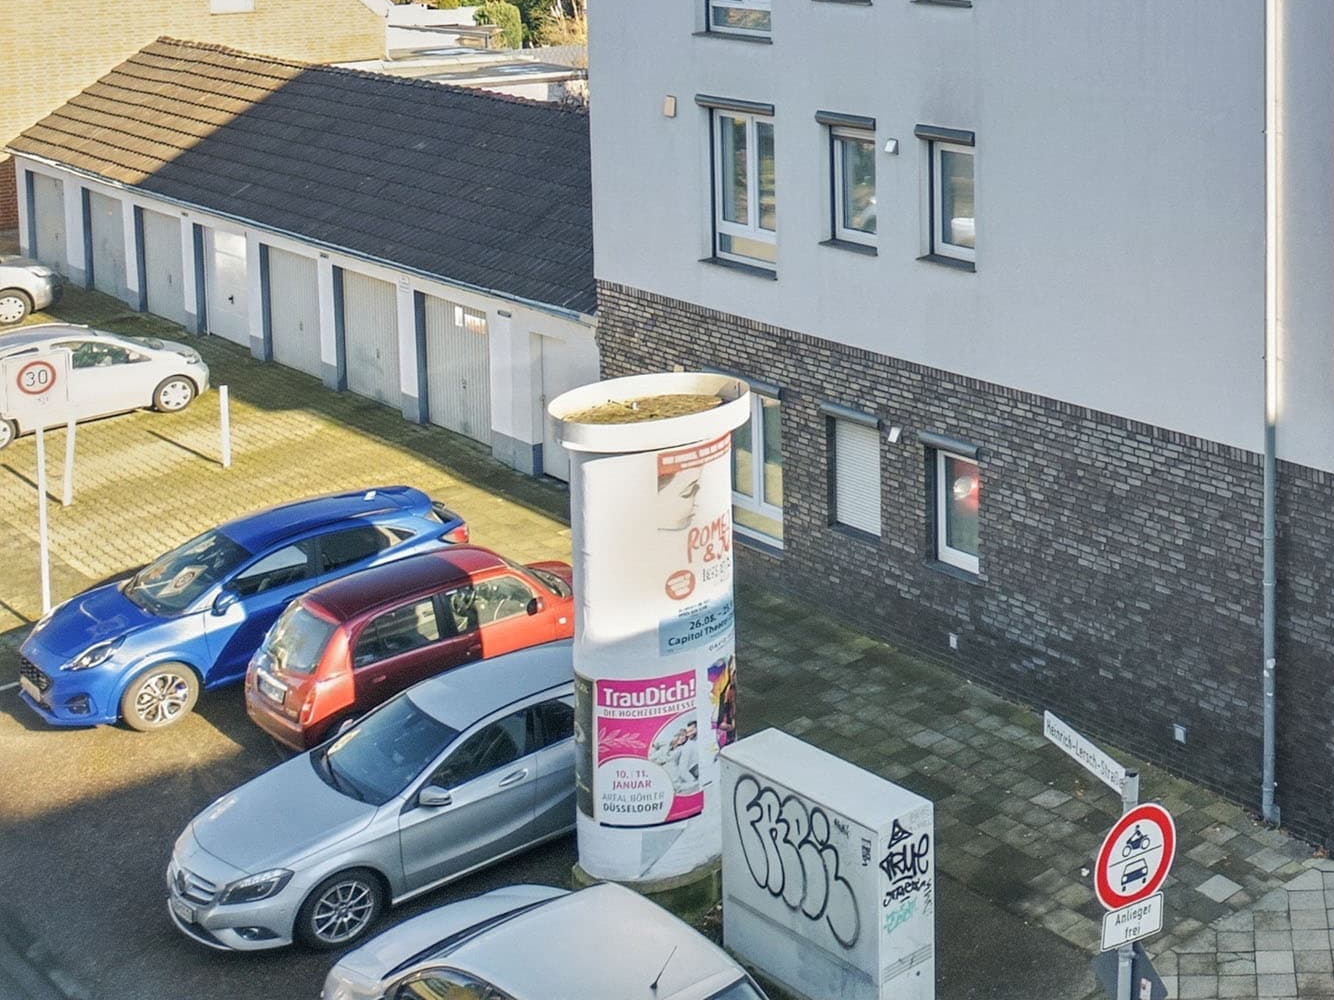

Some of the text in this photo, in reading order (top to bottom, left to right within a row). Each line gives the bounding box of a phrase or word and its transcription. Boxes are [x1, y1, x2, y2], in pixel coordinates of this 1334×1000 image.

[25, 369, 49, 387] 30
[668, 627, 703, 646] Capitol
[603, 679, 695, 707] TrauDich!
[612, 780, 651, 790] JANUAR
[603, 802, 664, 813] DÜSSELDORF
[1115, 903, 1152, 926] Anlieger
[1124, 921, 1141, 939] frei
